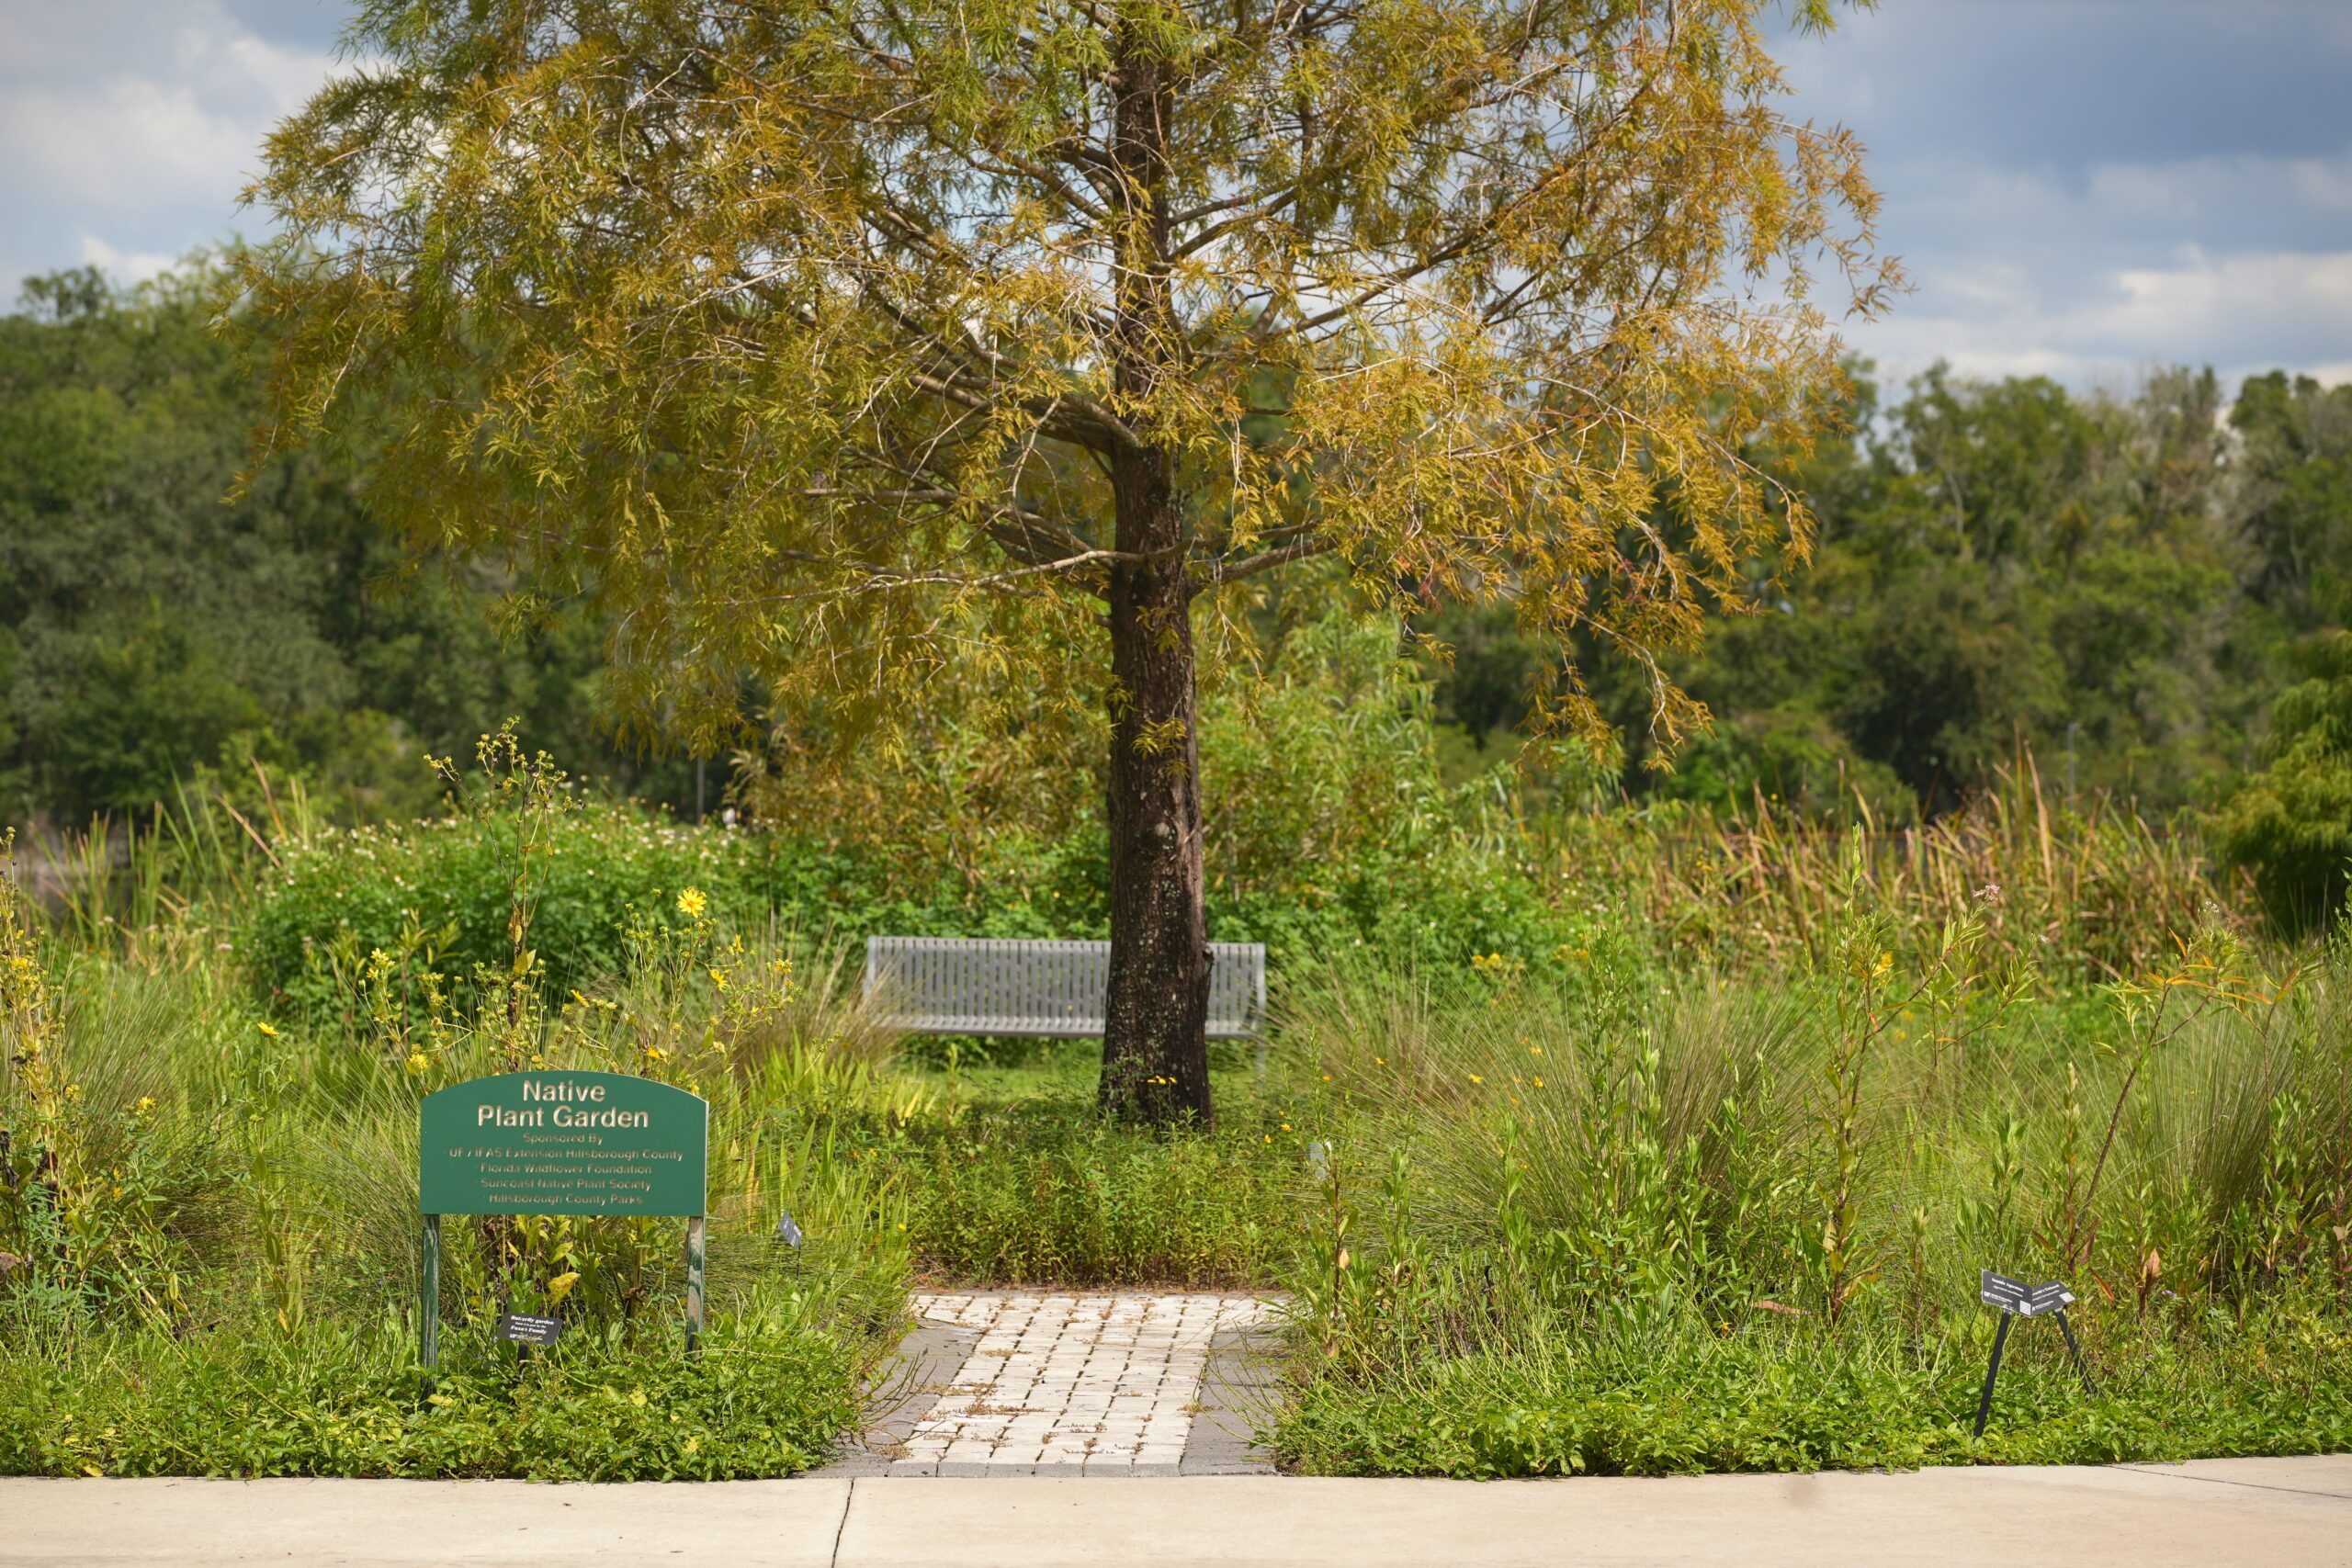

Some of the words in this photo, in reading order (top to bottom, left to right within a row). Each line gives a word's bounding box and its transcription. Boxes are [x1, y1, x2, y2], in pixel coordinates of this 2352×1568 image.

[524, 1079, 605, 1101] Native
[478, 1105, 544, 1126] Plant
[553, 1105, 649, 1127] Garden
[523, 1132, 584, 1145] Sponsored
[589, 1134, 603, 1145] By
[449, 1147, 462, 1157] UF
[475, 1147, 503, 1157] IFAS
[506, 1147, 562, 1158] Extension
[566, 1149, 639, 1161] Hillsborough
[642, 1149, 684, 1162] County
[481, 1163, 520, 1173] Florida
[525, 1163, 582, 1173] Wildflower
[587, 1164, 652, 1174] Foundation
[481, 1178, 534, 1188] Suncoast
[537, 1179, 573, 1189] Native
[577, 1179, 605, 1189] Plant
[609, 1179, 651, 1191] Society
[489, 1193, 562, 1205] Hillsborough
[566, 1193, 605, 1206] County
[610, 1194, 643, 1205] Parks
